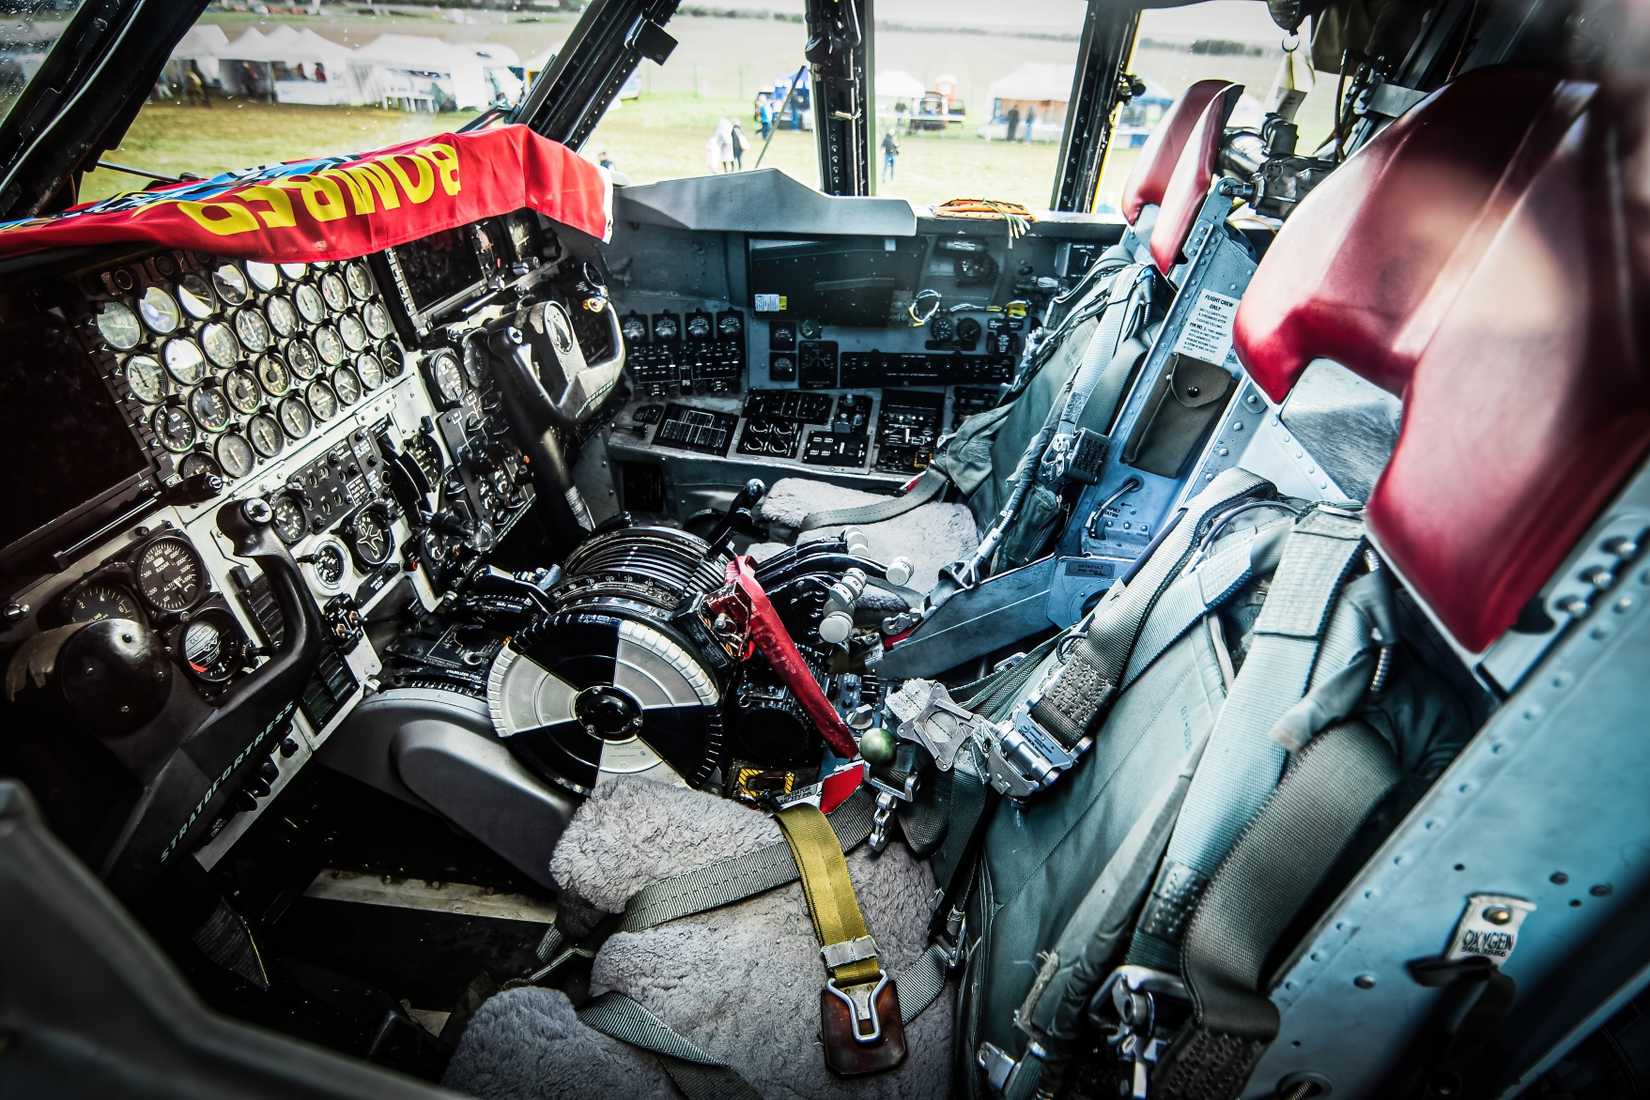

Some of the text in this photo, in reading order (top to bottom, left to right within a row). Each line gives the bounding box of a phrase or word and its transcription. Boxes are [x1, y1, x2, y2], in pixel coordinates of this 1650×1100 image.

[1205, 294, 1234, 308] FLIGHT CREW
[160, 700, 295, 863] STRATOFORTRESS
[1463, 929, 1514, 951] OXYGEN
